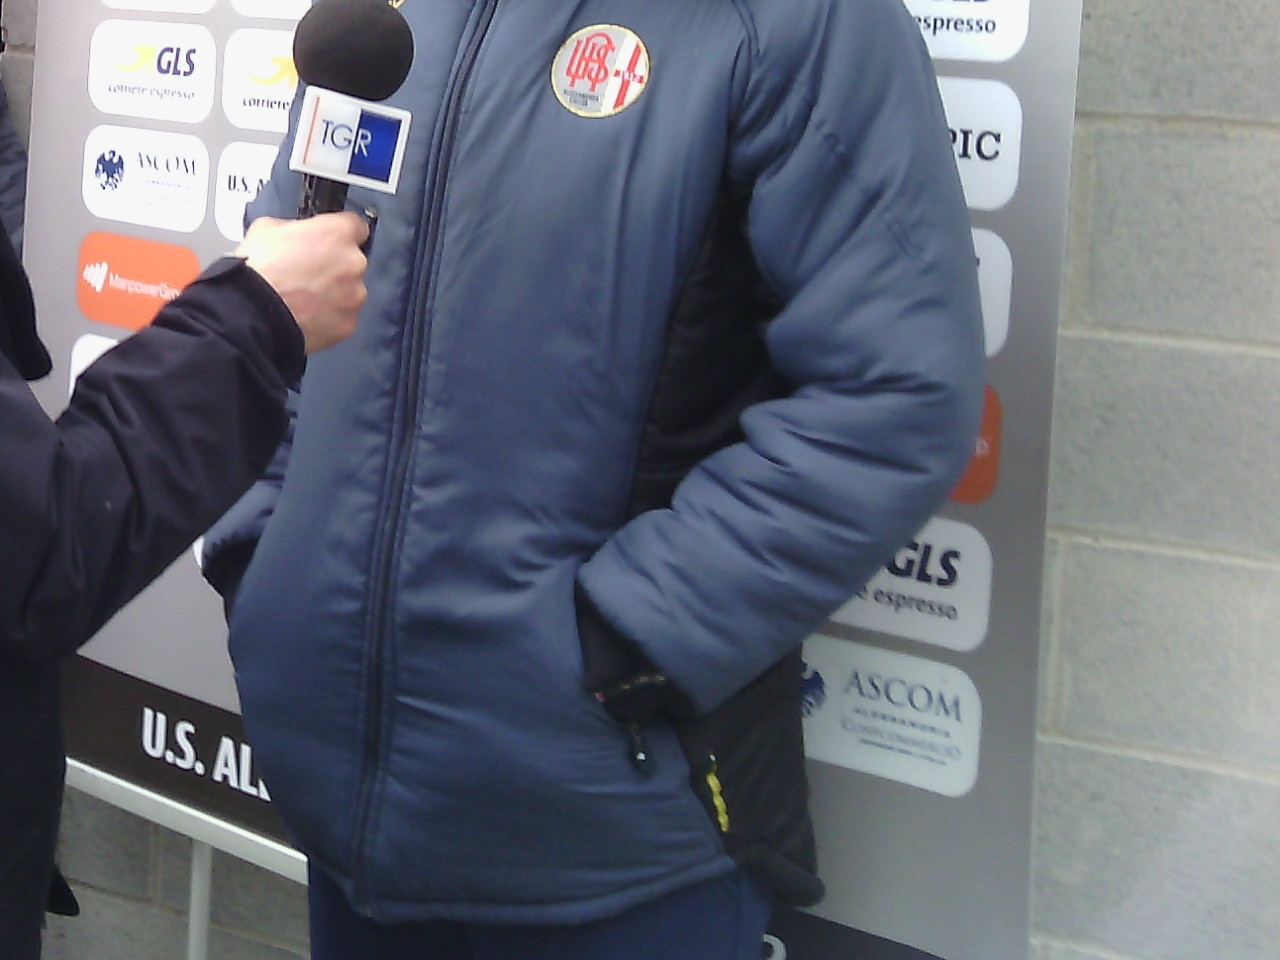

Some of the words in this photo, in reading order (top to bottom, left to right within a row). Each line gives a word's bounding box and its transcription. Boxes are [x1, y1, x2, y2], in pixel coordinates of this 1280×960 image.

[157, 46, 196, 77] GLS
[320, 118, 371, 158] TGR
[885, 542, 960, 585] GLS
[873, 589, 958, 620] espresso
[842, 669, 962, 723] ASCOM
[141, 706, 206, 776] U.S.
